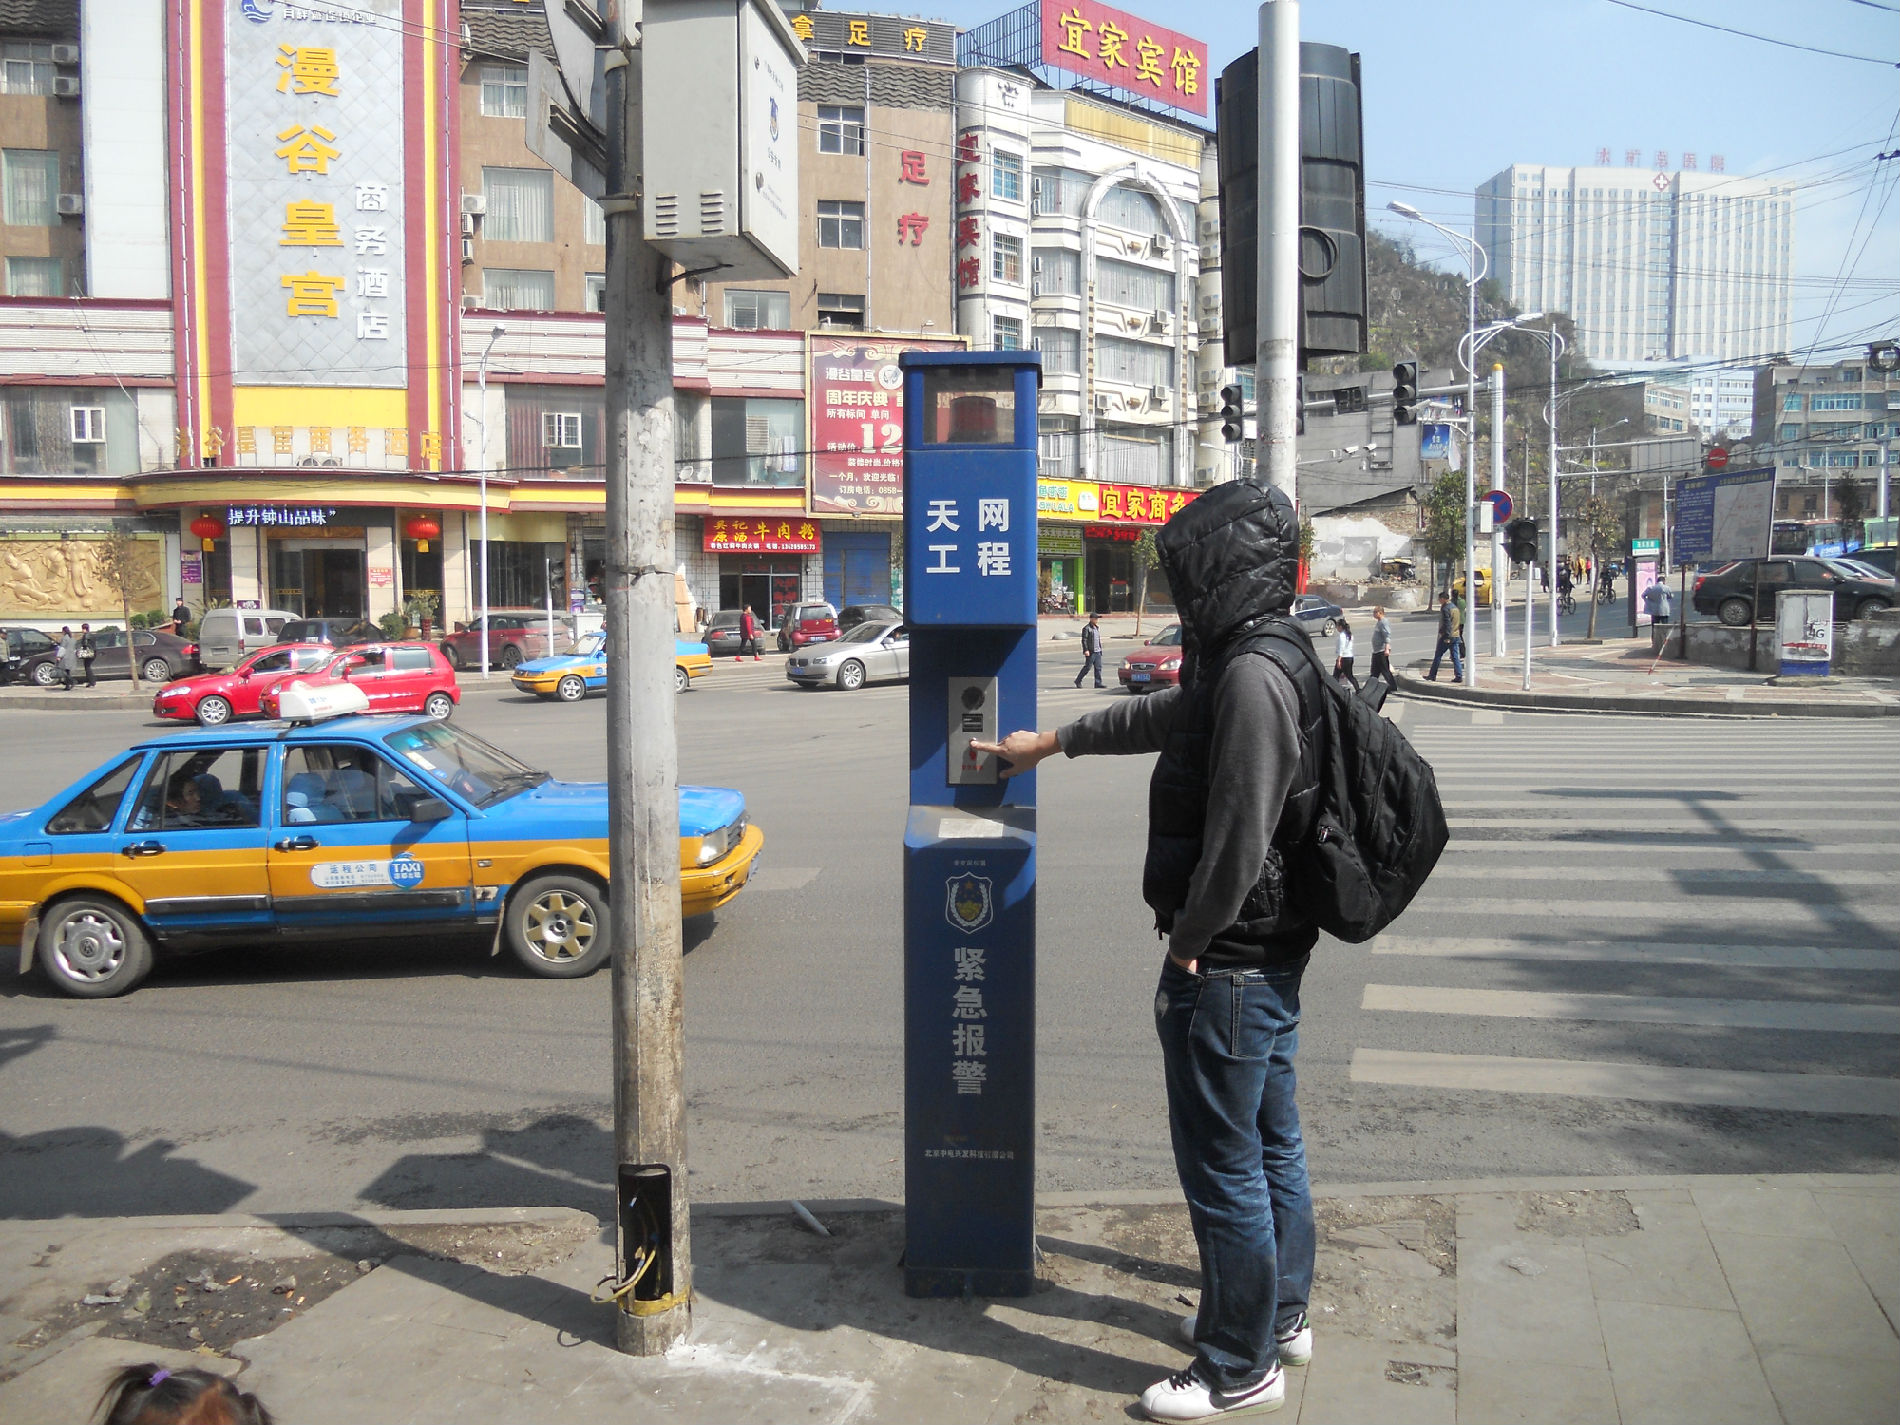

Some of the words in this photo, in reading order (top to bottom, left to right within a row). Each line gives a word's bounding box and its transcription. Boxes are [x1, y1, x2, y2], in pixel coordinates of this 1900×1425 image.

[1058, 8, 1201, 96] 宜家宾馆
[275, 43, 346, 318] 漫谷皇宫
[897, 150, 930, 246] 足疗
[957, 133, 982, 289] 宜家宾馆
[354, 184, 389, 340] 商务酒店
[825, 389, 889, 407] 周年庆典
[826, 408, 866, 420] 所有标间
[753, 521, 816, 542] 牛肉粉
[926, 498, 1011, 533] 天网
[926, 541, 1012, 577] 工程
[392, 862, 421, 873] TAXI
[951, 947, 988, 1096] 紧急报警
